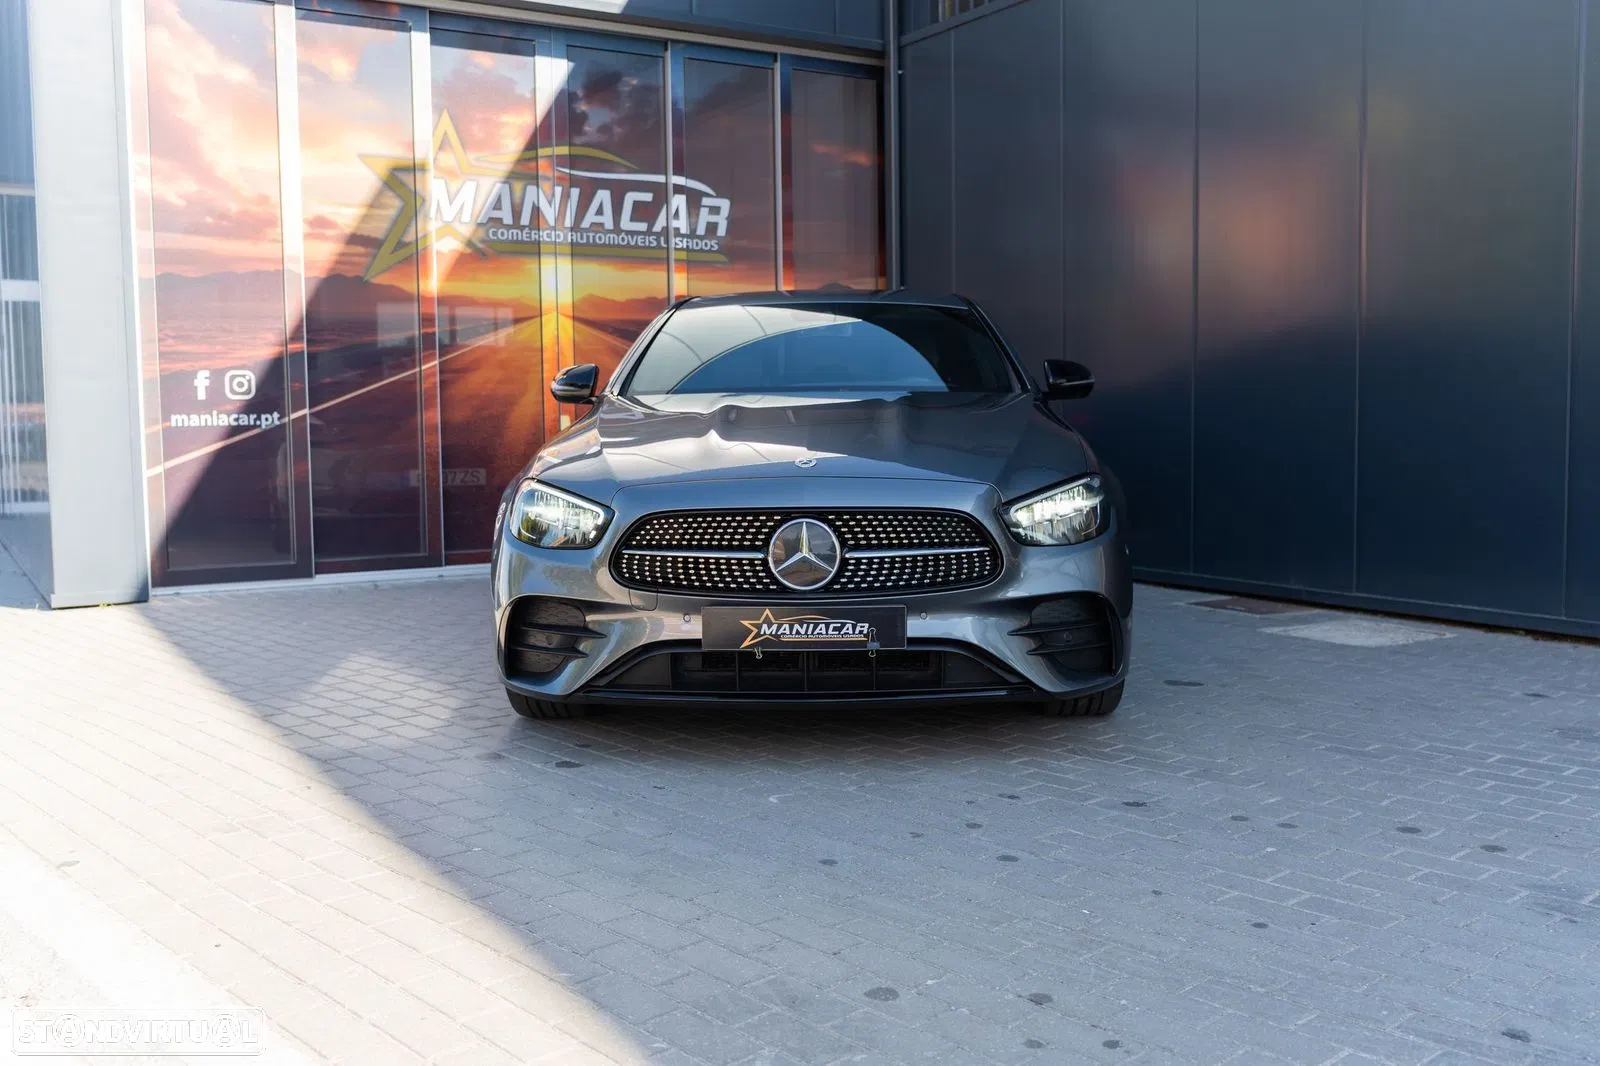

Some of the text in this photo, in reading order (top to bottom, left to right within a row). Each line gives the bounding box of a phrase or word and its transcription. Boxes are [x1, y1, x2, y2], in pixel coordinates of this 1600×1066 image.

[430, 177, 730, 237] MANIACAR
[567, 229, 657, 247] AUTOMÓVEIS
[170, 410, 281, 429] maniacar.pt
[760, 623, 869, 635] MANIACAR
